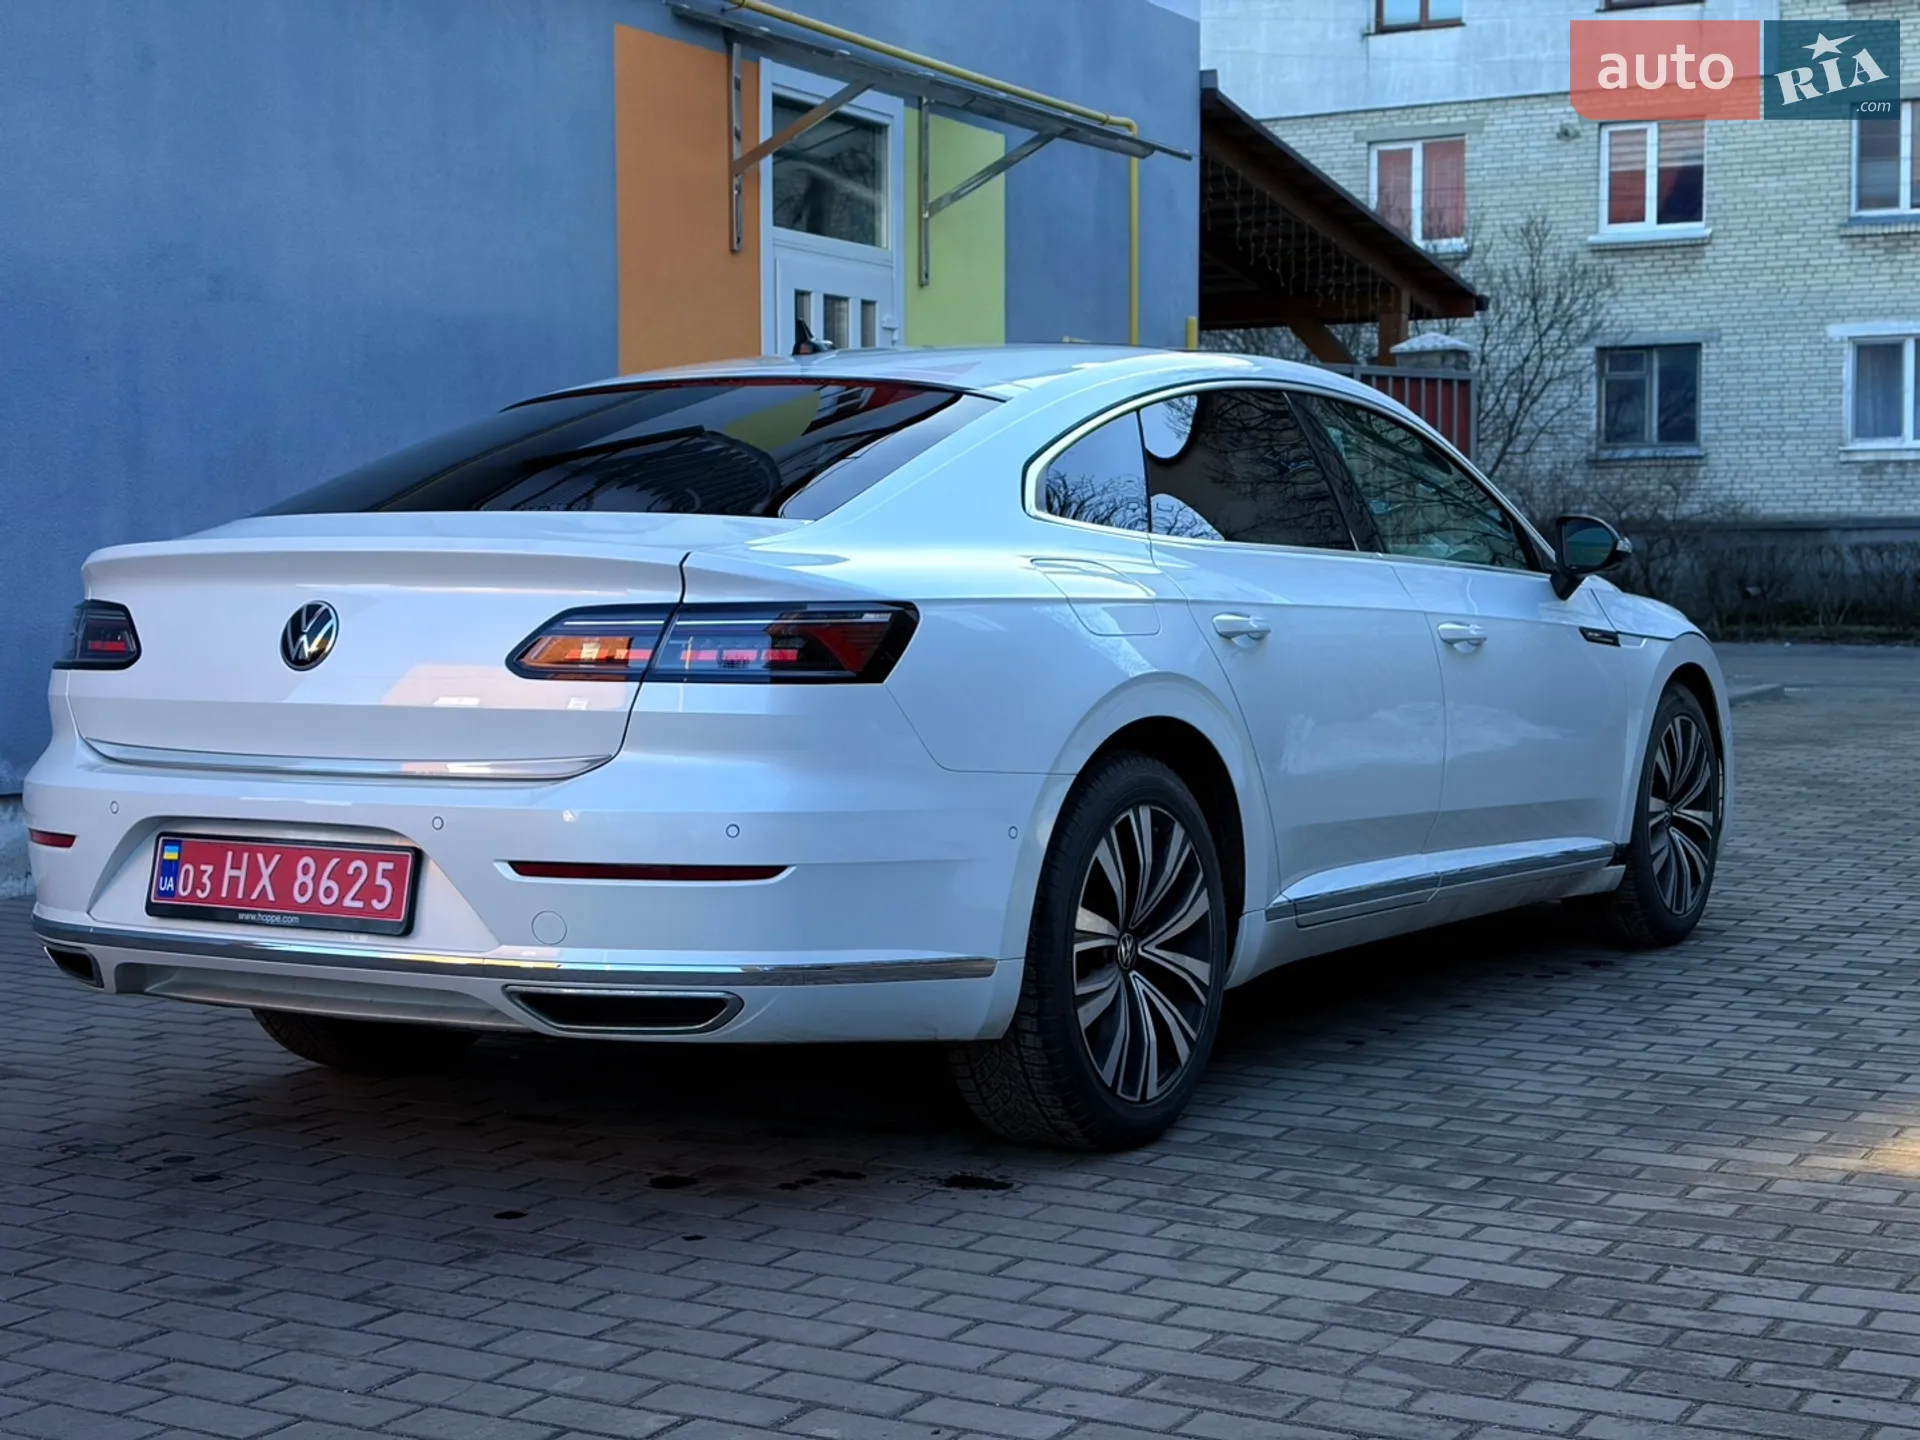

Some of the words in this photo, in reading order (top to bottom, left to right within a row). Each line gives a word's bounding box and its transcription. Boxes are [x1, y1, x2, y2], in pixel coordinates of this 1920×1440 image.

[159, 876, 174, 891] UA
[178, 863, 214, 899] 03
[221, 850, 281, 902] HX
[292, 856, 395, 911] 8625
